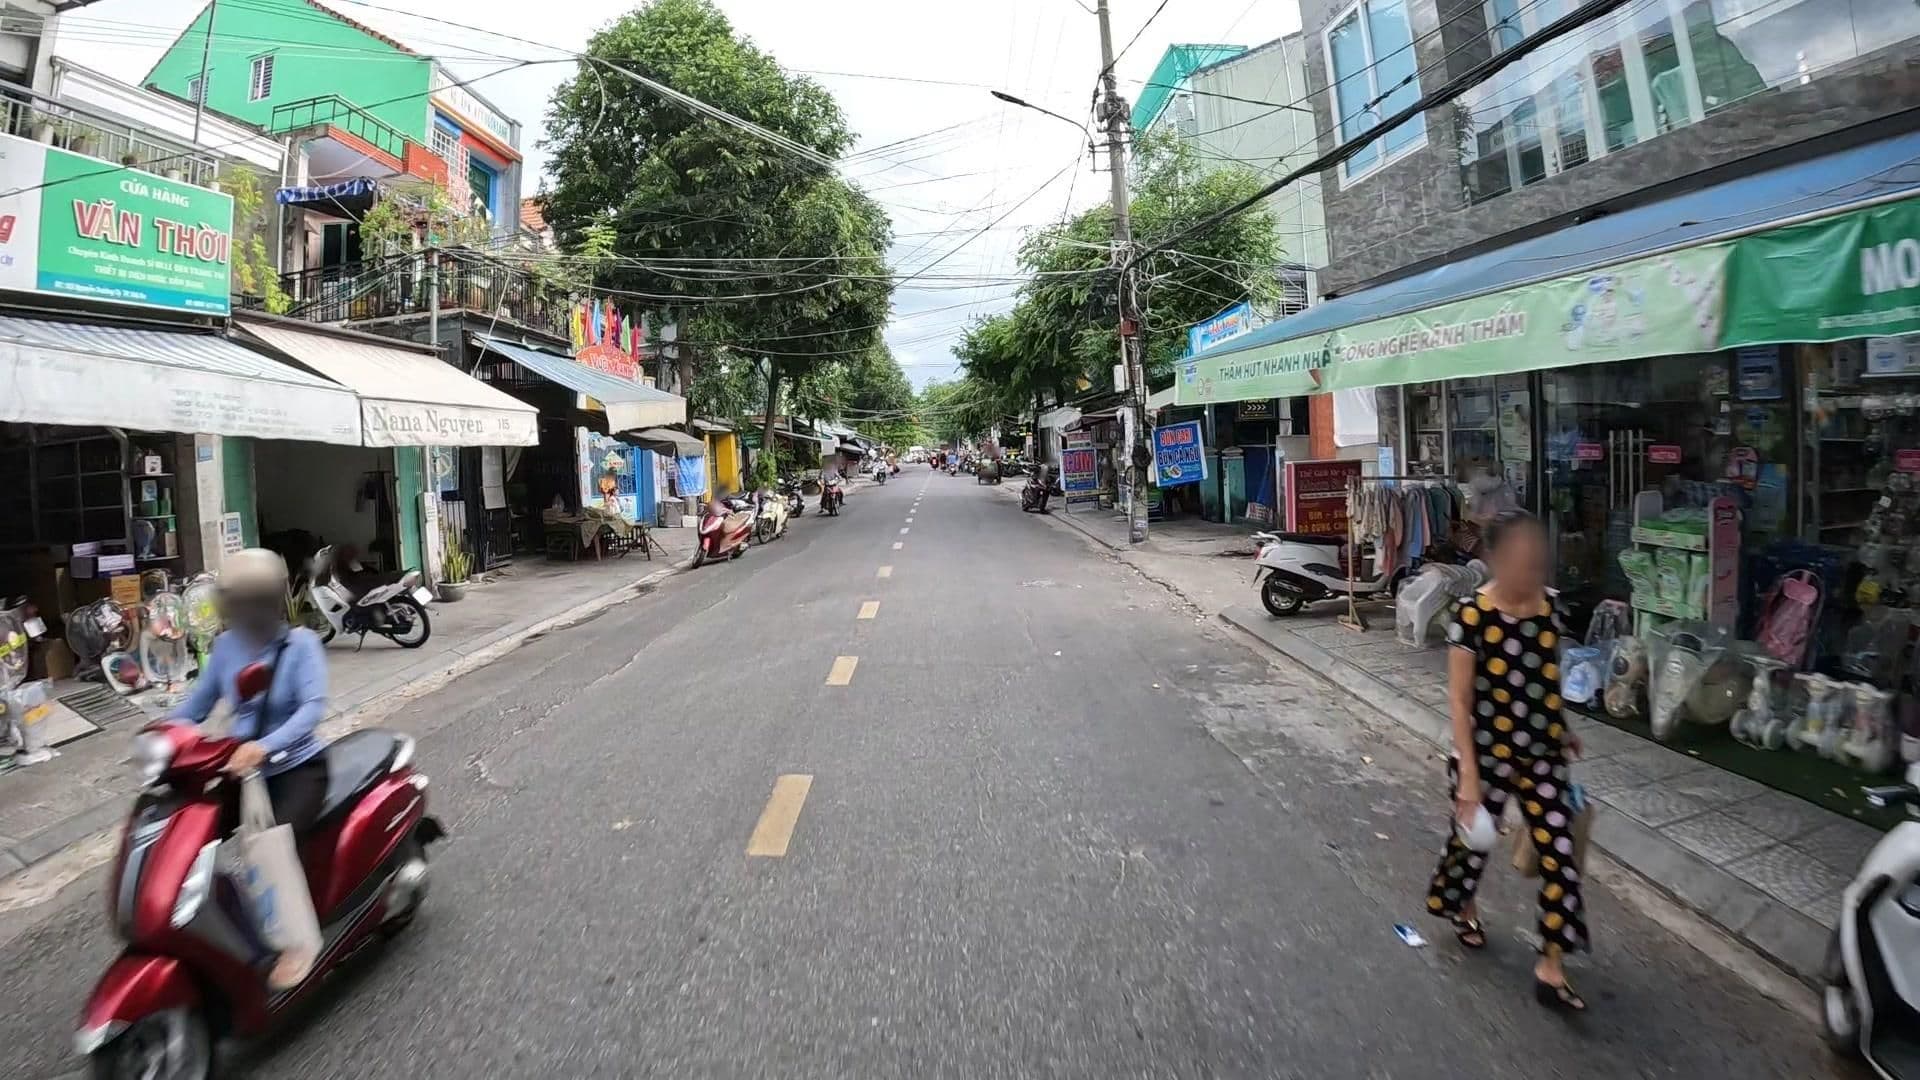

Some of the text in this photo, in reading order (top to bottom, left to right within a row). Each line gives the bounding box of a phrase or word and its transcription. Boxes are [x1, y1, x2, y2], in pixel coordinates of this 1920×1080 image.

[119, 178, 190, 207] CỬA HÀNG
[73, 198, 228, 264] VĂN THỜI
[1263, 354, 1301, 375] NHANH
[372, 406, 422, 432] Nana
[1157, 449, 1174, 467] BÚN
